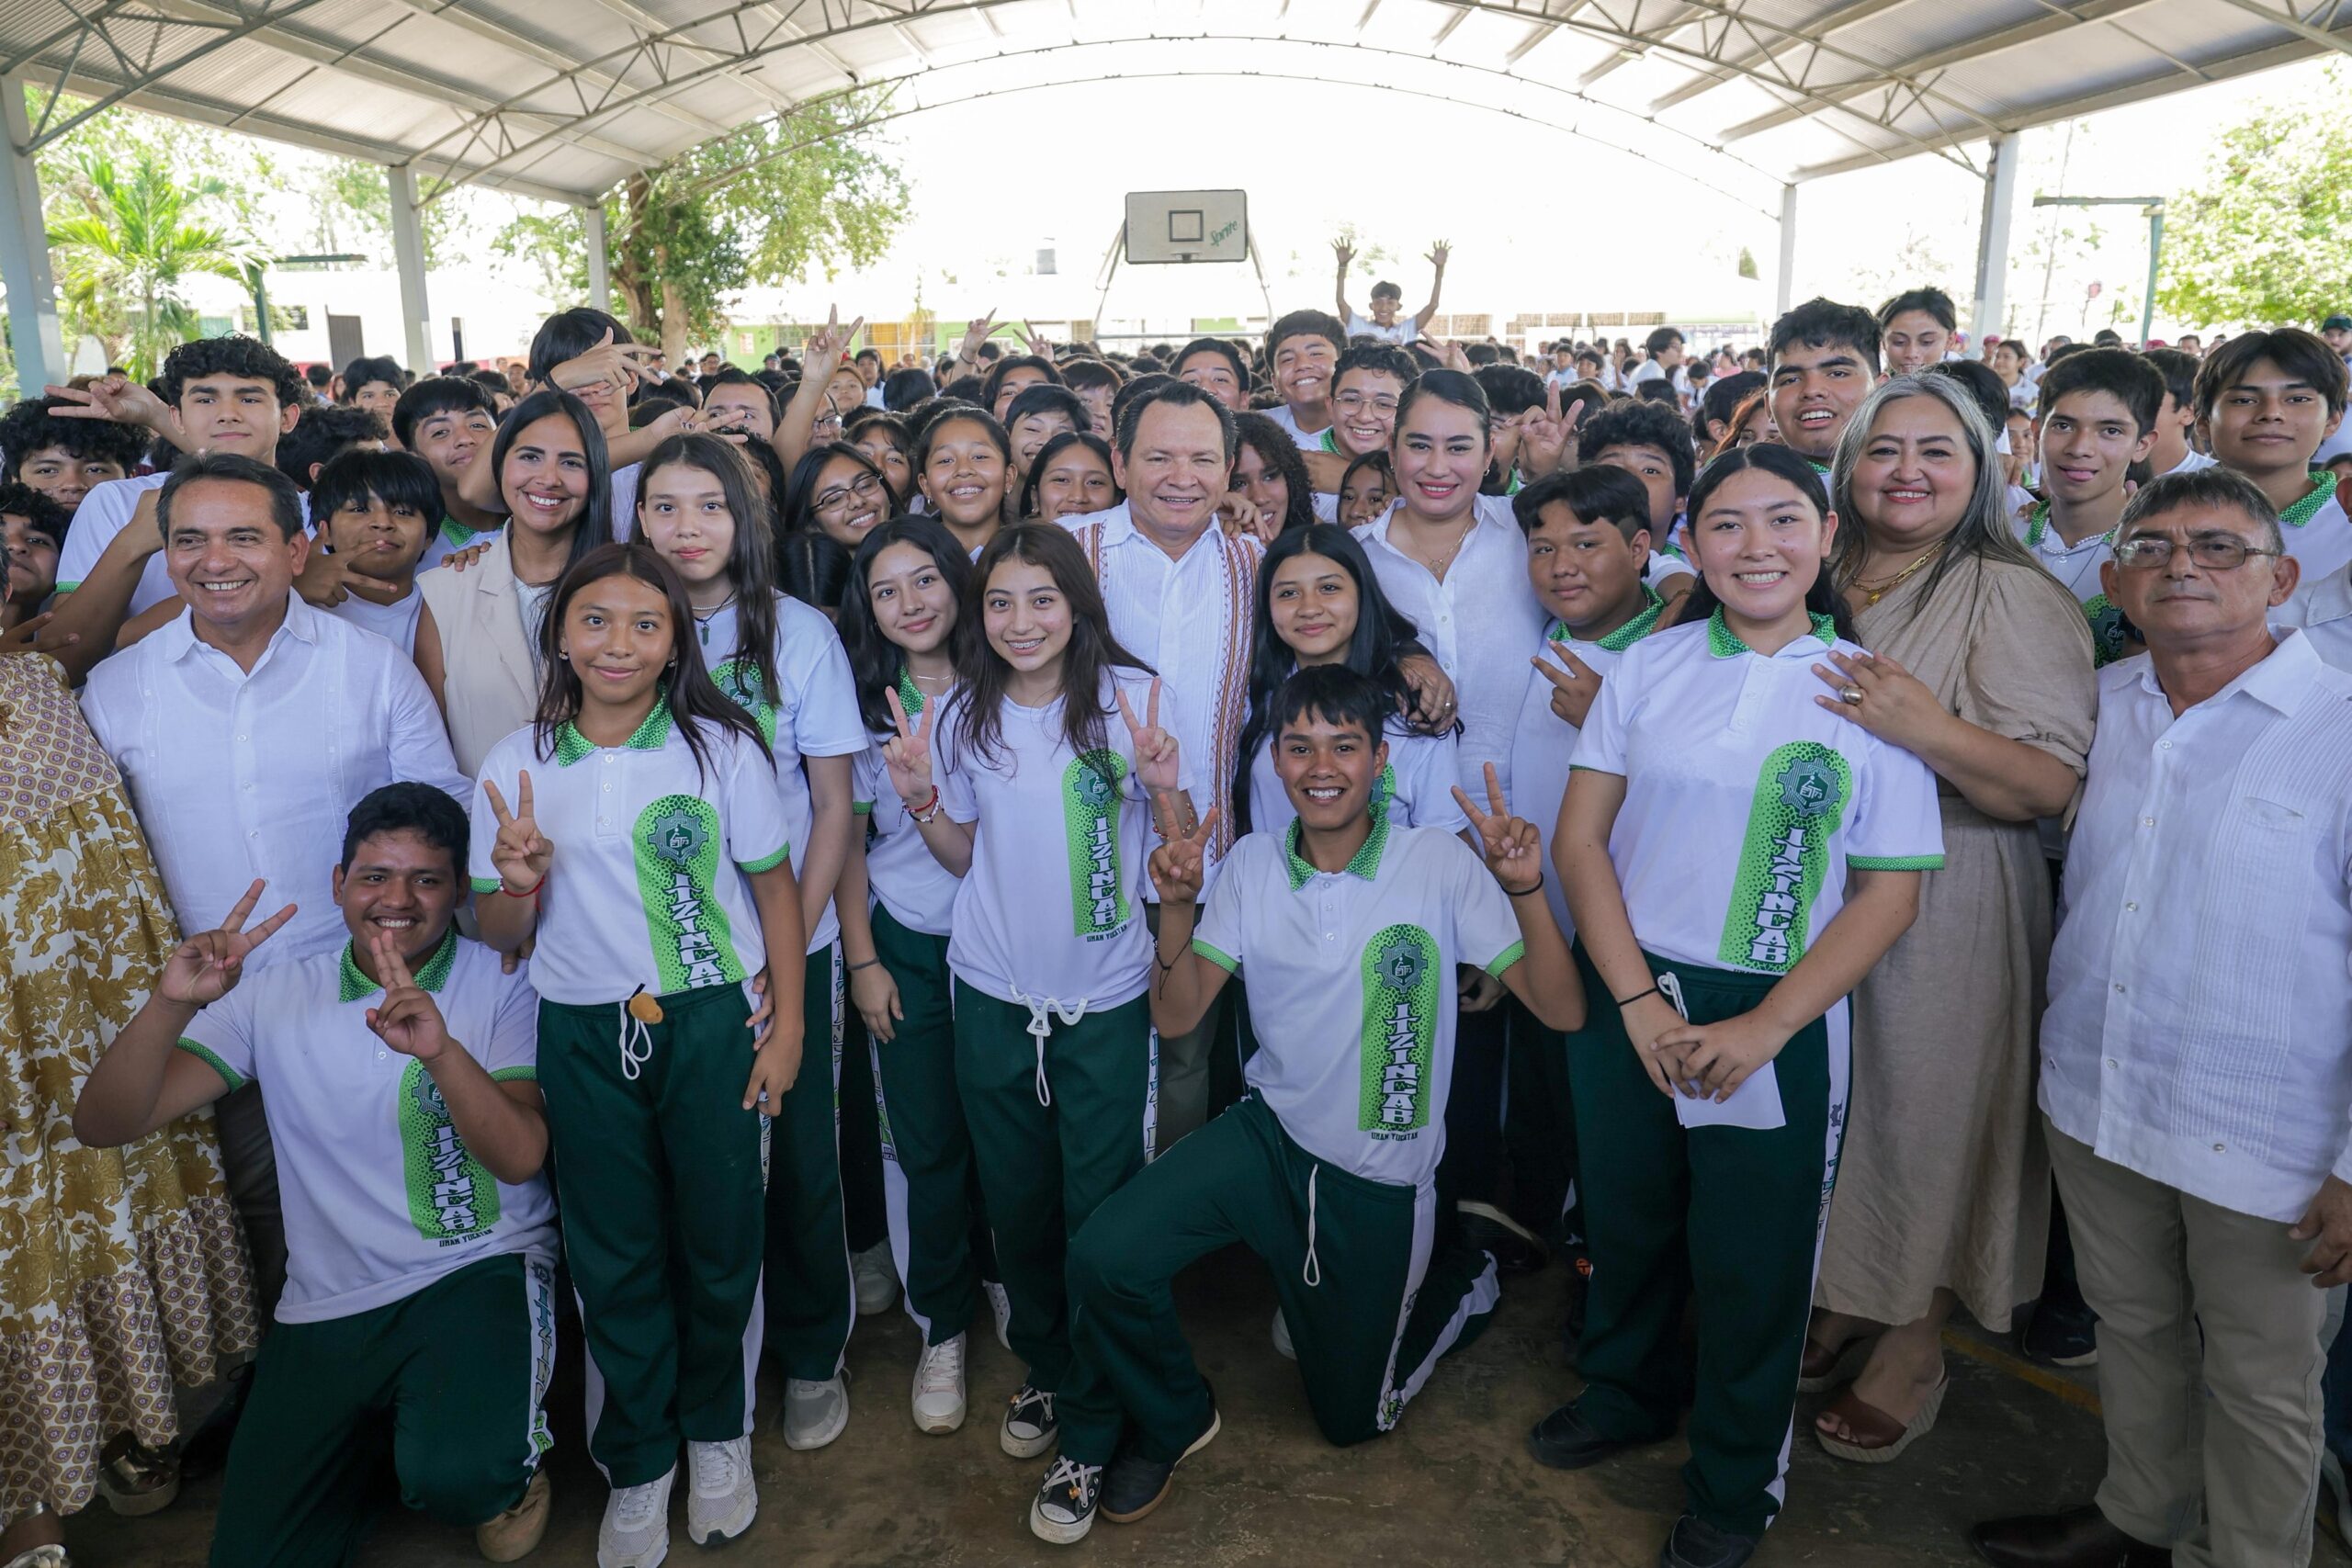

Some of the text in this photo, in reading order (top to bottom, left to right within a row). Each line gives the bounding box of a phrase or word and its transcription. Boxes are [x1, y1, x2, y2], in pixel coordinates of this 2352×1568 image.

[1210, 220, 1238, 246] Sprite
[1087, 816, 1116, 926] ITZINCAB
[1747, 827, 1813, 964] ITZINCAB
[1381, 1002, 1422, 1124] ITZINCAB
